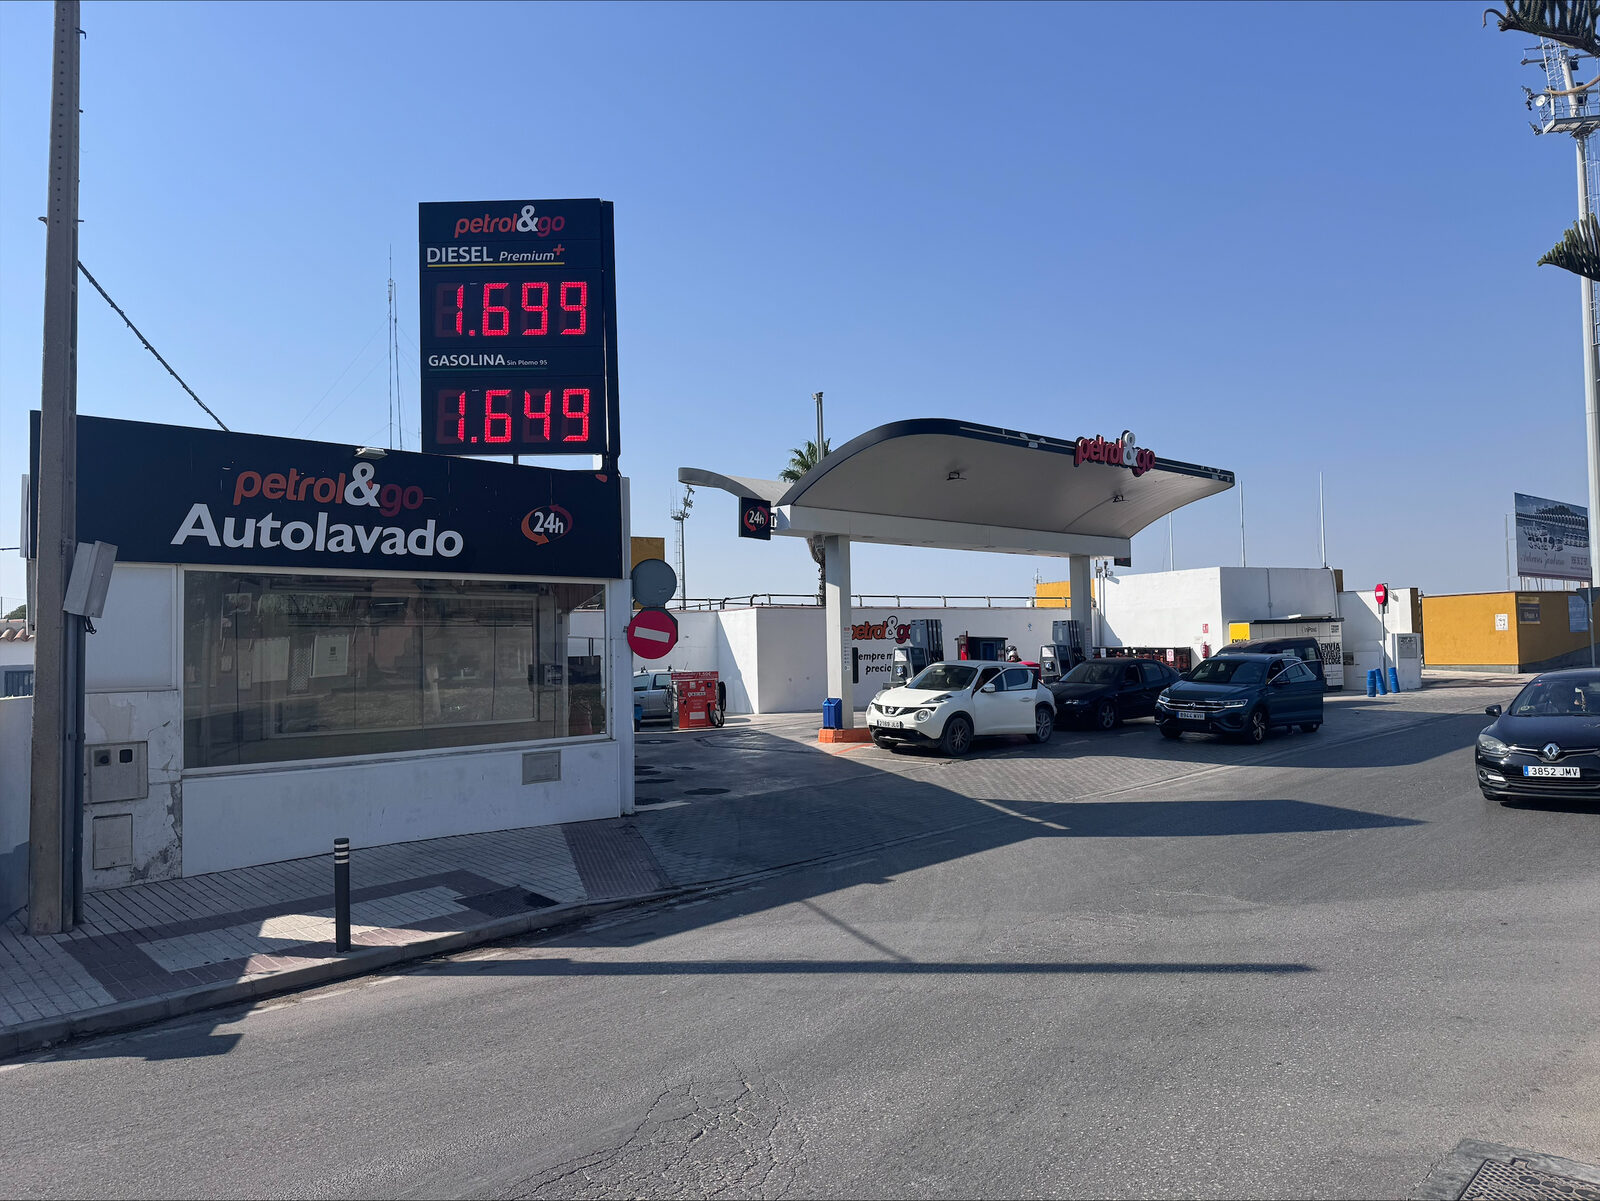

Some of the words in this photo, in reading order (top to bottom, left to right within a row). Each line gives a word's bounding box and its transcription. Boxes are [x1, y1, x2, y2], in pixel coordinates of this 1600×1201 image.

[454, 205, 565, 238] petrol&go
[427, 246, 493, 263] DIESEL
[455, 281, 588, 336] 1.699
[428, 354, 505, 367] GASOLINA
[457, 388, 590, 443] 1.649
[1074, 430, 1155, 477] petrol&go
[233, 461, 425, 517] petrol&go
[170, 503, 464, 558] Autolavado
[533, 510, 564, 534] 24h
[748, 510, 764, 524] 24h
[1532, 768, 1556, 776] 3852
[1560, 768, 1578, 776] JMV
